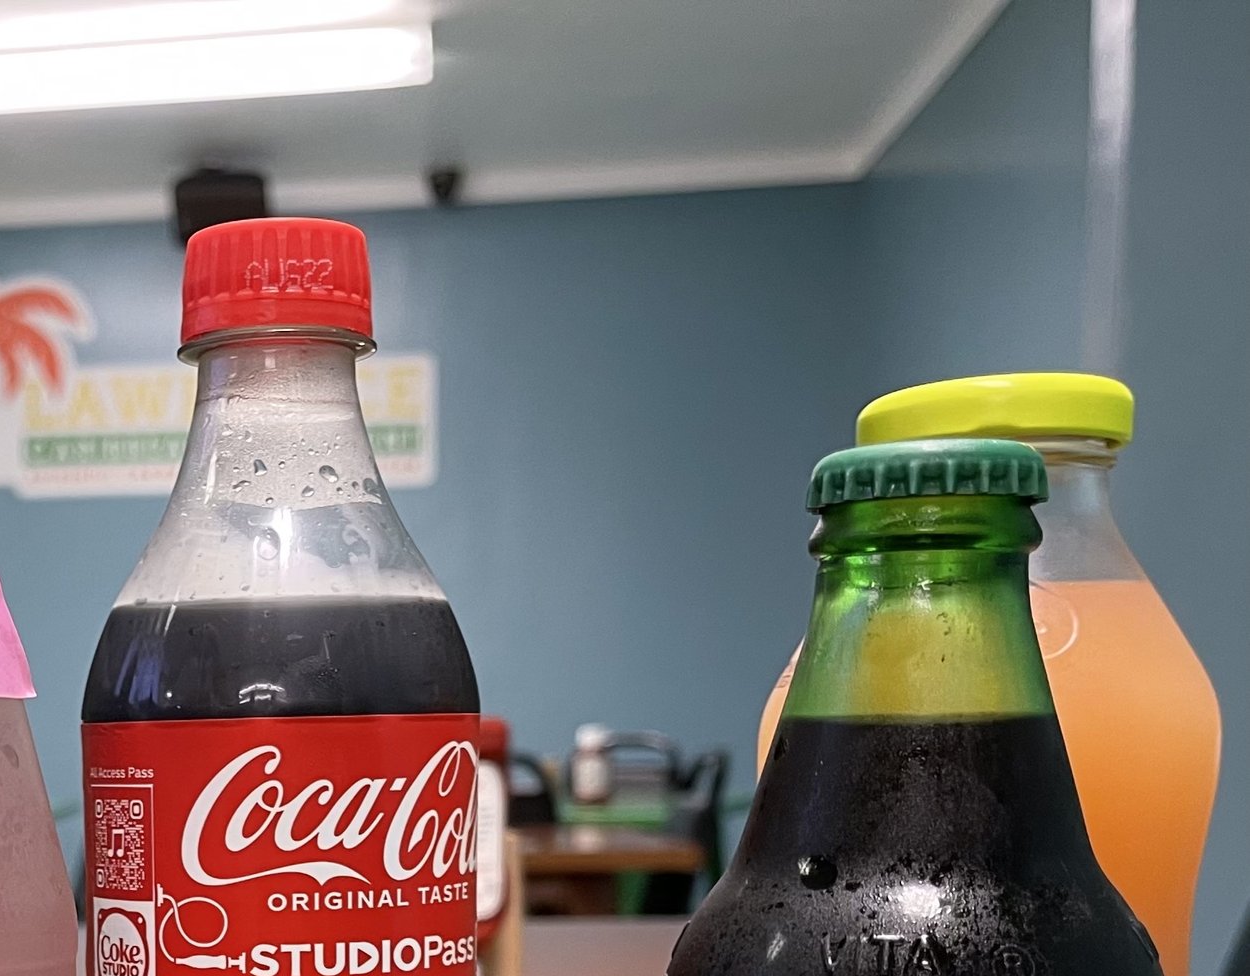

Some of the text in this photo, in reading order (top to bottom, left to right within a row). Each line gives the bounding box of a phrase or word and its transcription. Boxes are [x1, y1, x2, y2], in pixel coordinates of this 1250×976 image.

[244, 258, 334, 291] AUG22
[98, 767, 127, 779] Access
[128, 766, 155, 779] Pass
[267, 881, 470, 913] ORIGINAL TASTE
[101, 934, 143, 965] Coke
